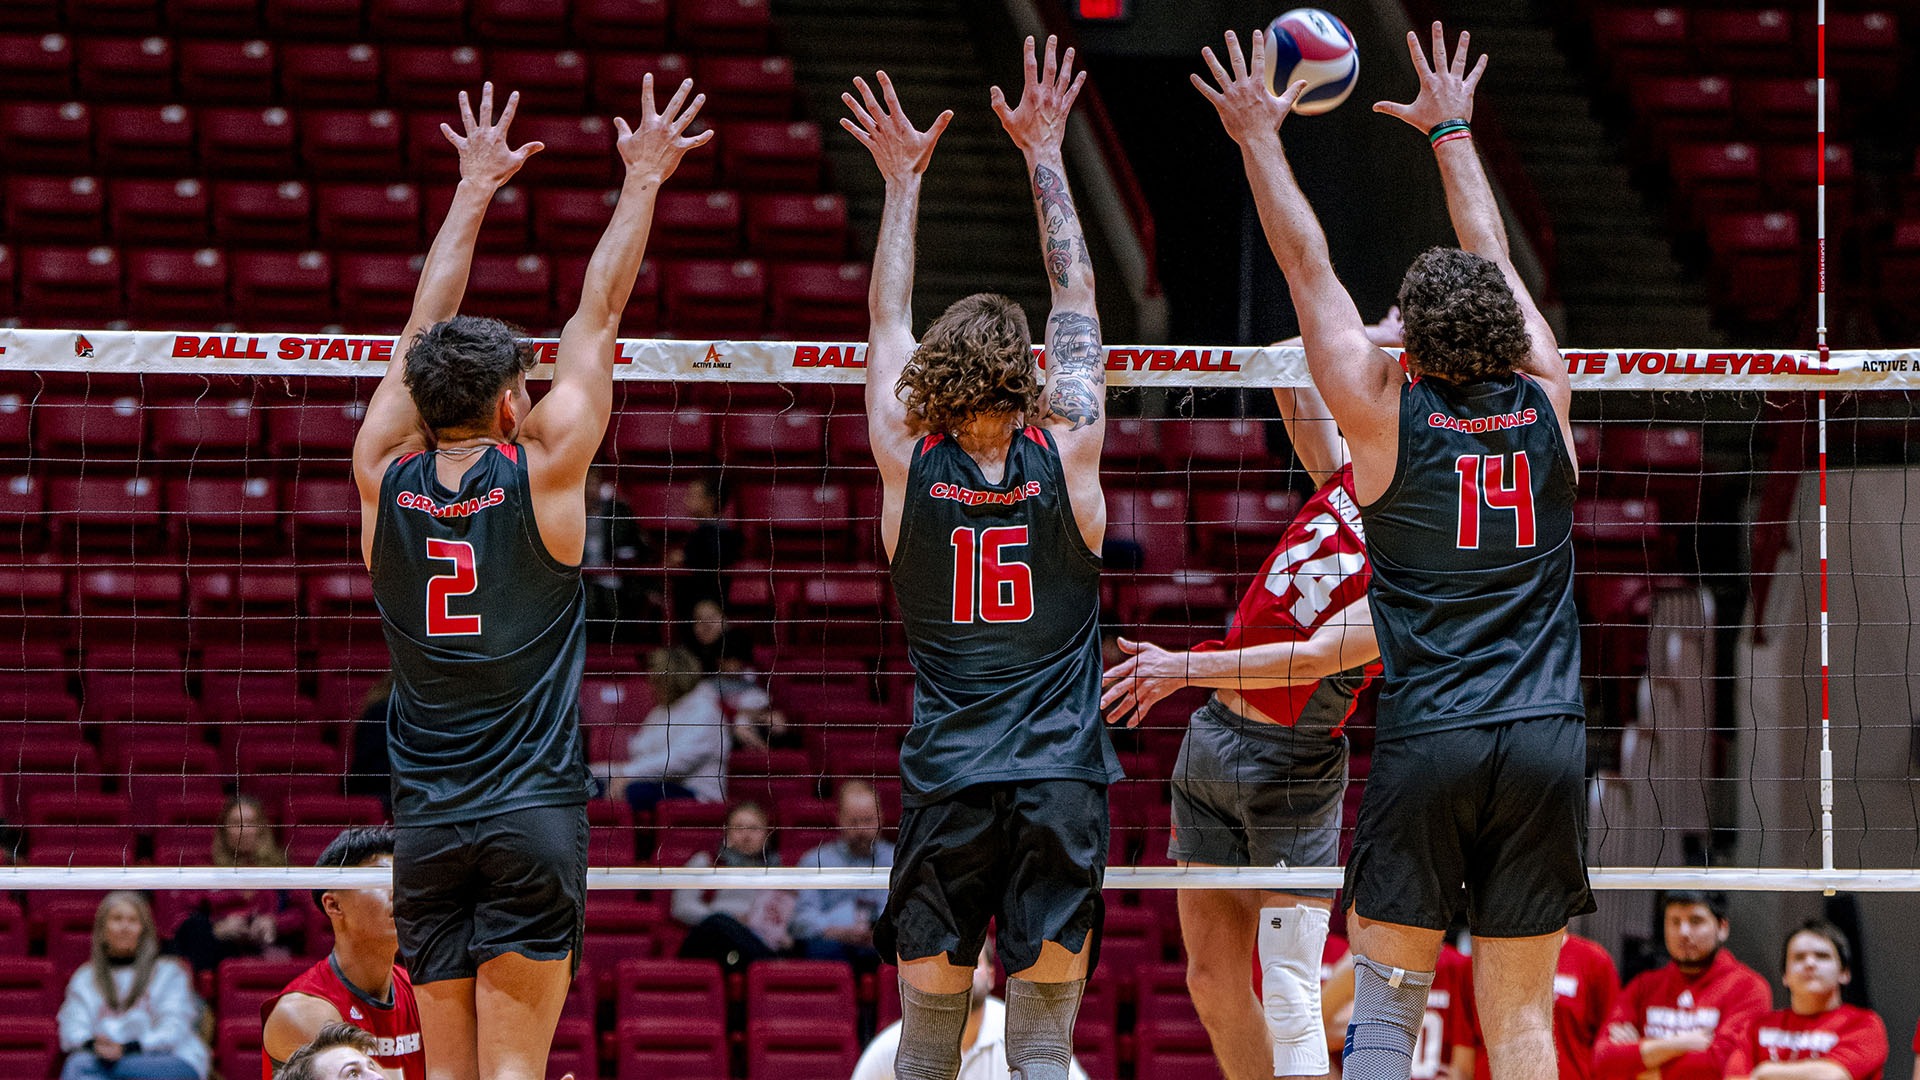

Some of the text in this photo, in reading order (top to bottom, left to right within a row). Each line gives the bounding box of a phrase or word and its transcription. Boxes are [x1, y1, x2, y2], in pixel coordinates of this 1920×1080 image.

[172, 336, 395, 361] BALL STATE
[792, 346, 869, 368] BAL
[1031, 349, 1241, 371] EYBALL
[1616, 352, 1840, 375] VOLLEYBALL
[1862, 361, 1908, 372] ACTIVE
[1428, 408, 1537, 434] CARDINALS
[1455, 450, 1536, 549] 14
[951, 525, 1034, 623] 16
[1265, 512, 1365, 629] 24
[426, 537, 481, 637] 2
